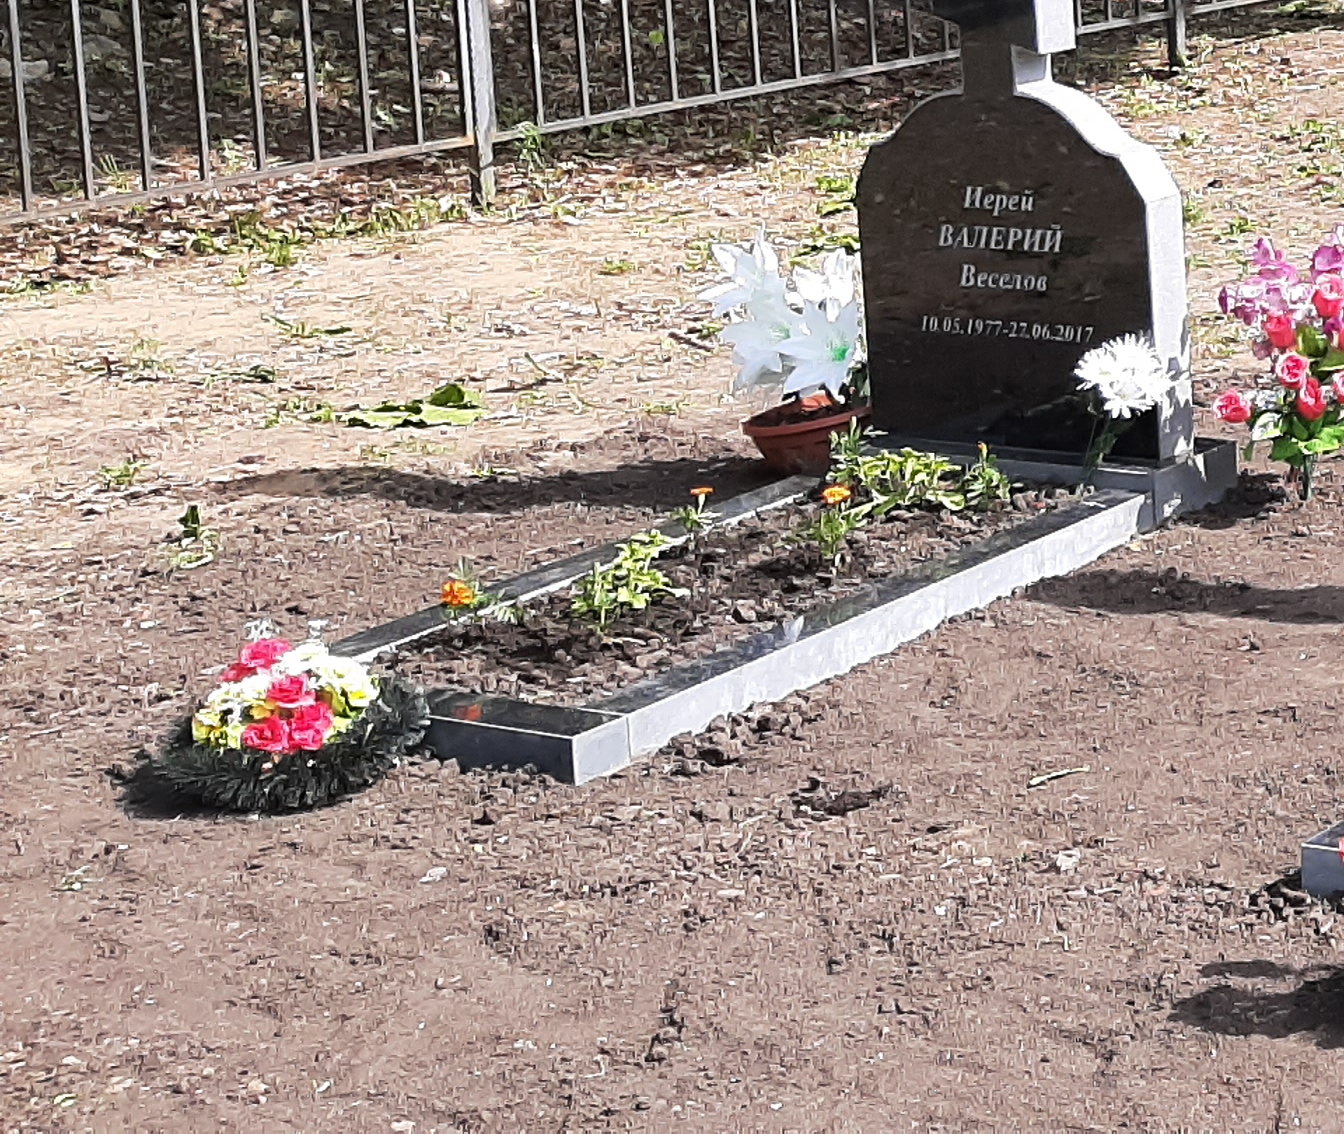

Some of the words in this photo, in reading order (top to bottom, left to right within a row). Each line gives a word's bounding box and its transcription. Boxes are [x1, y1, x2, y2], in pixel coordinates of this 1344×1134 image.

[963, 185, 1035, 217] Иерей
[938, 223, 1063, 254] ВАЛЕРИЙ
[960, 263, 1049, 292] Веселов
